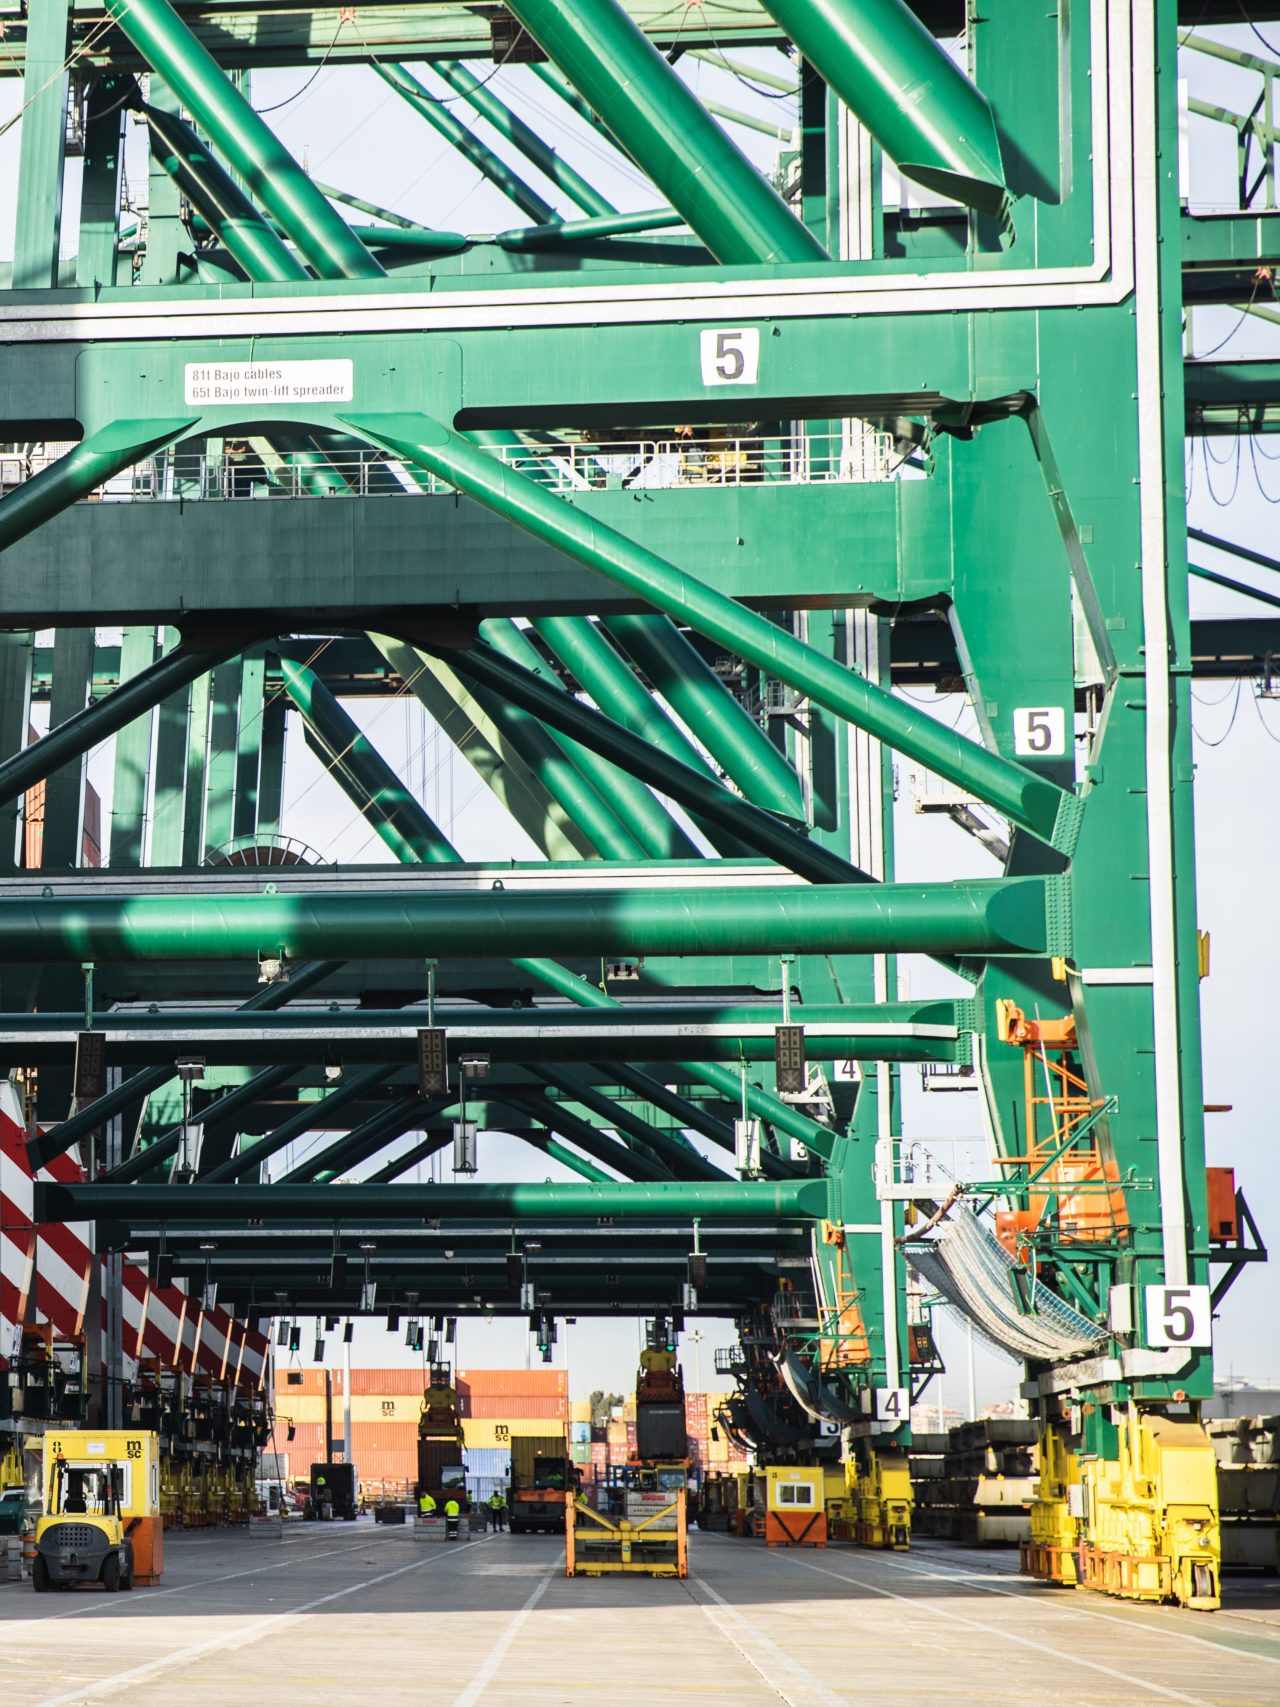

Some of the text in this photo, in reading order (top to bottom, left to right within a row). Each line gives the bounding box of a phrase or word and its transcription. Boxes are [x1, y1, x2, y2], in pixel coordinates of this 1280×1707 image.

[716, 332, 745, 380] 5
[192, 368, 282, 383] 81t Bajo cables
[192, 384, 345, 400] 65t Bajo twin-lift spreader
[1027, 711, 1052, 751] 5
[841, 1060, 856, 1079] 4
[1163, 1289, 1195, 1342] 5
[884, 1391, 902, 1418] 4
